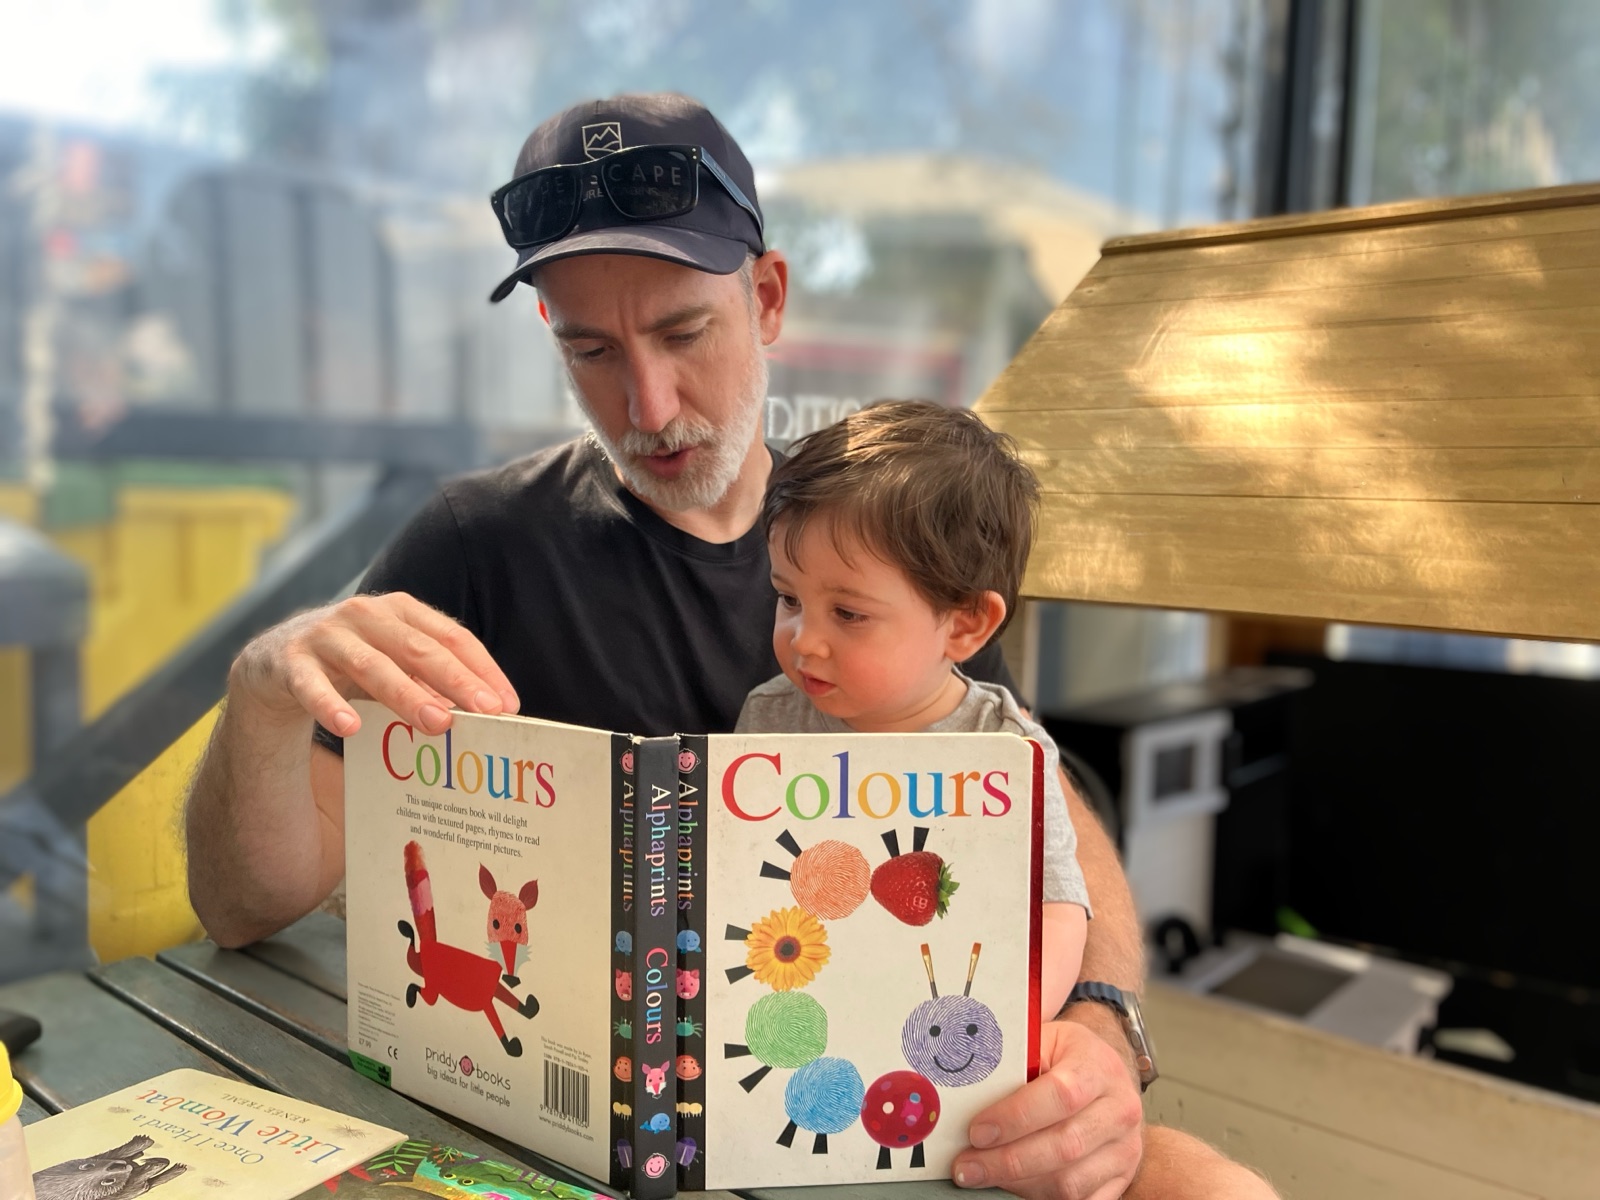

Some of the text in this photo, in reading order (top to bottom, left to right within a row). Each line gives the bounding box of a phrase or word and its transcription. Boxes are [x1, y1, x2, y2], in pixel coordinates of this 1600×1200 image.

[382, 721, 556, 808] Colours
[721, 750, 1012, 822] Colours
[396, 806, 540, 846] children with textured pages, rhymes to read
[406, 793, 528, 829] This unique colours book will delight
[410, 825, 523, 858] and wonderful fingerprint pictures.
[678, 780, 699, 910] Alphaprints
[645, 784, 672, 1045] Alphaprints Colours
[425, 1047, 511, 1091] priddy books
[427, 1063, 511, 1107] big ideas for little people
[135, 1089, 345, 1164] Little Wombat
[139, 1118, 203, 1142] Heard
[195, 1137, 213, 1147] I
[539, 1115, 595, 1142] www.priddybooks.com
[213, 1141, 264, 1165] Once
